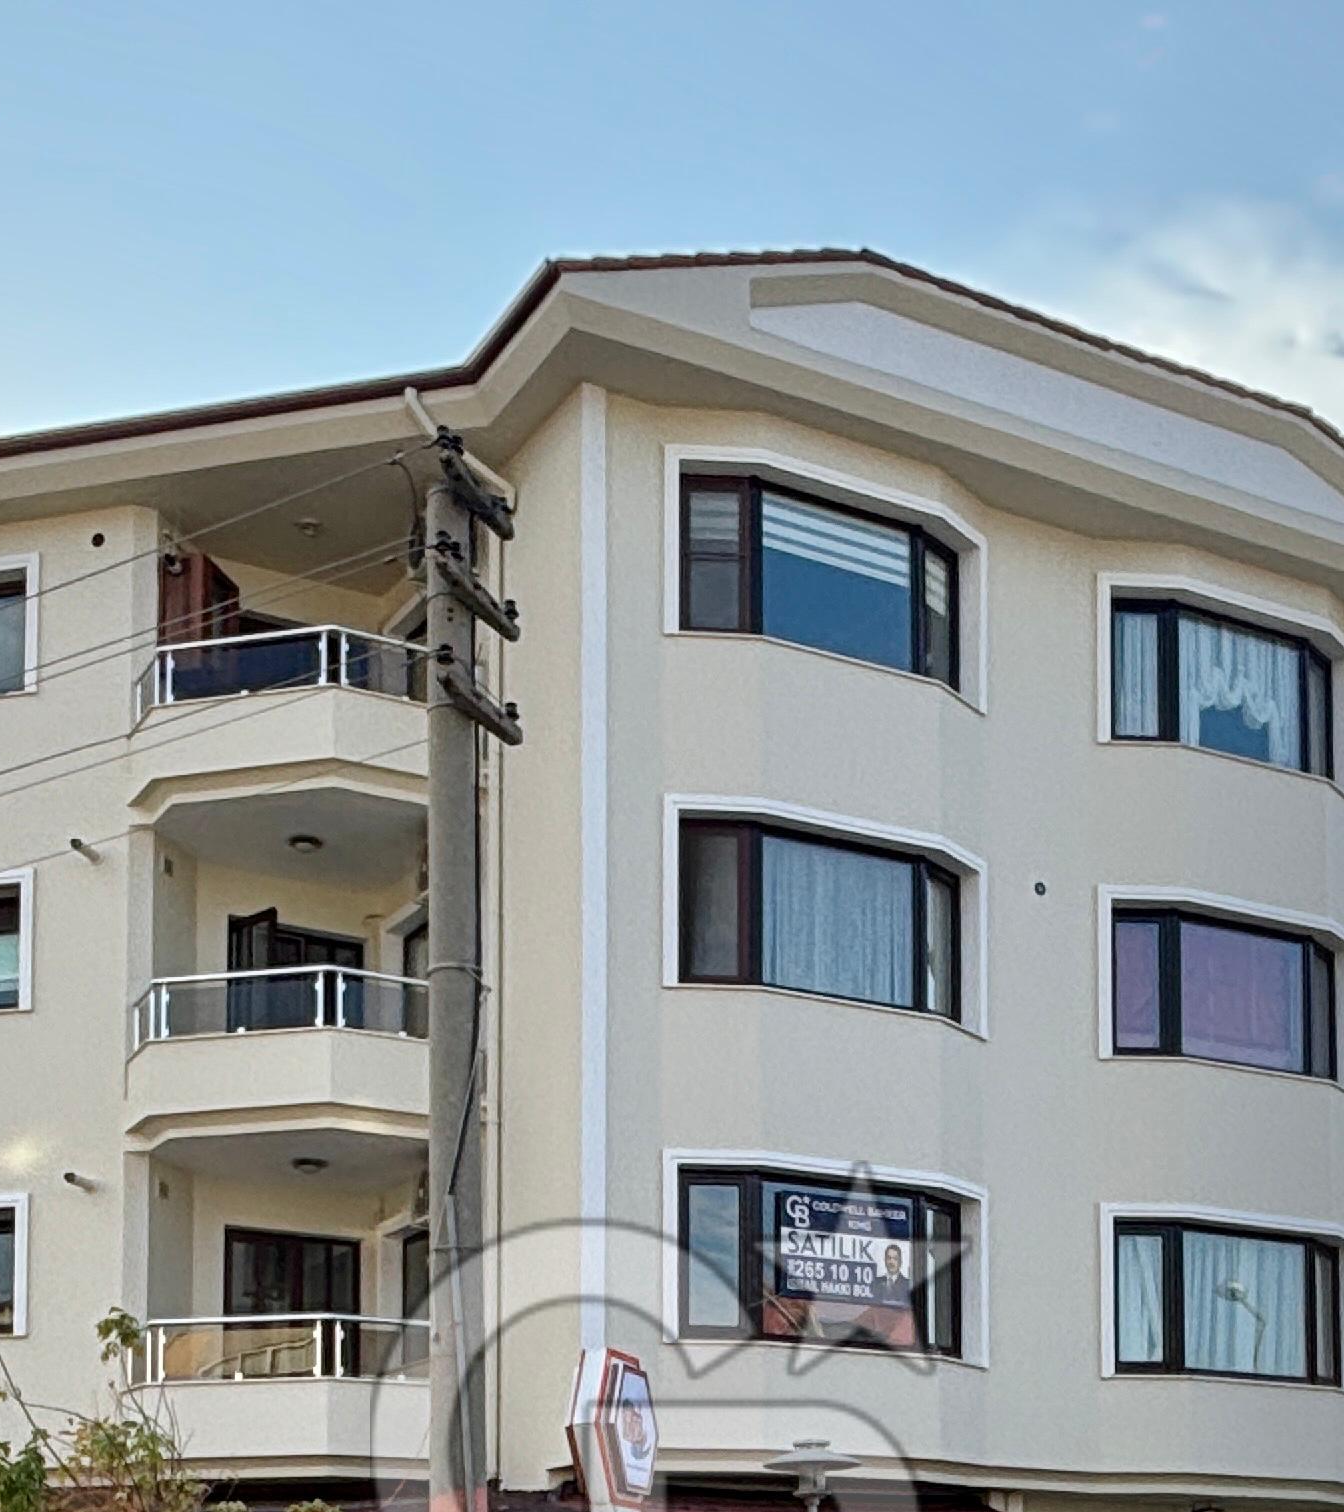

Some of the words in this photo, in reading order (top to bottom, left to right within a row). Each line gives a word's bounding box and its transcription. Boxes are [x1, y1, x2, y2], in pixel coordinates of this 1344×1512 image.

[787, 1230, 874, 1261] SATILIK
[830, 1263, 850, 1282] 10
[854, 1266, 874, 1284] 10
